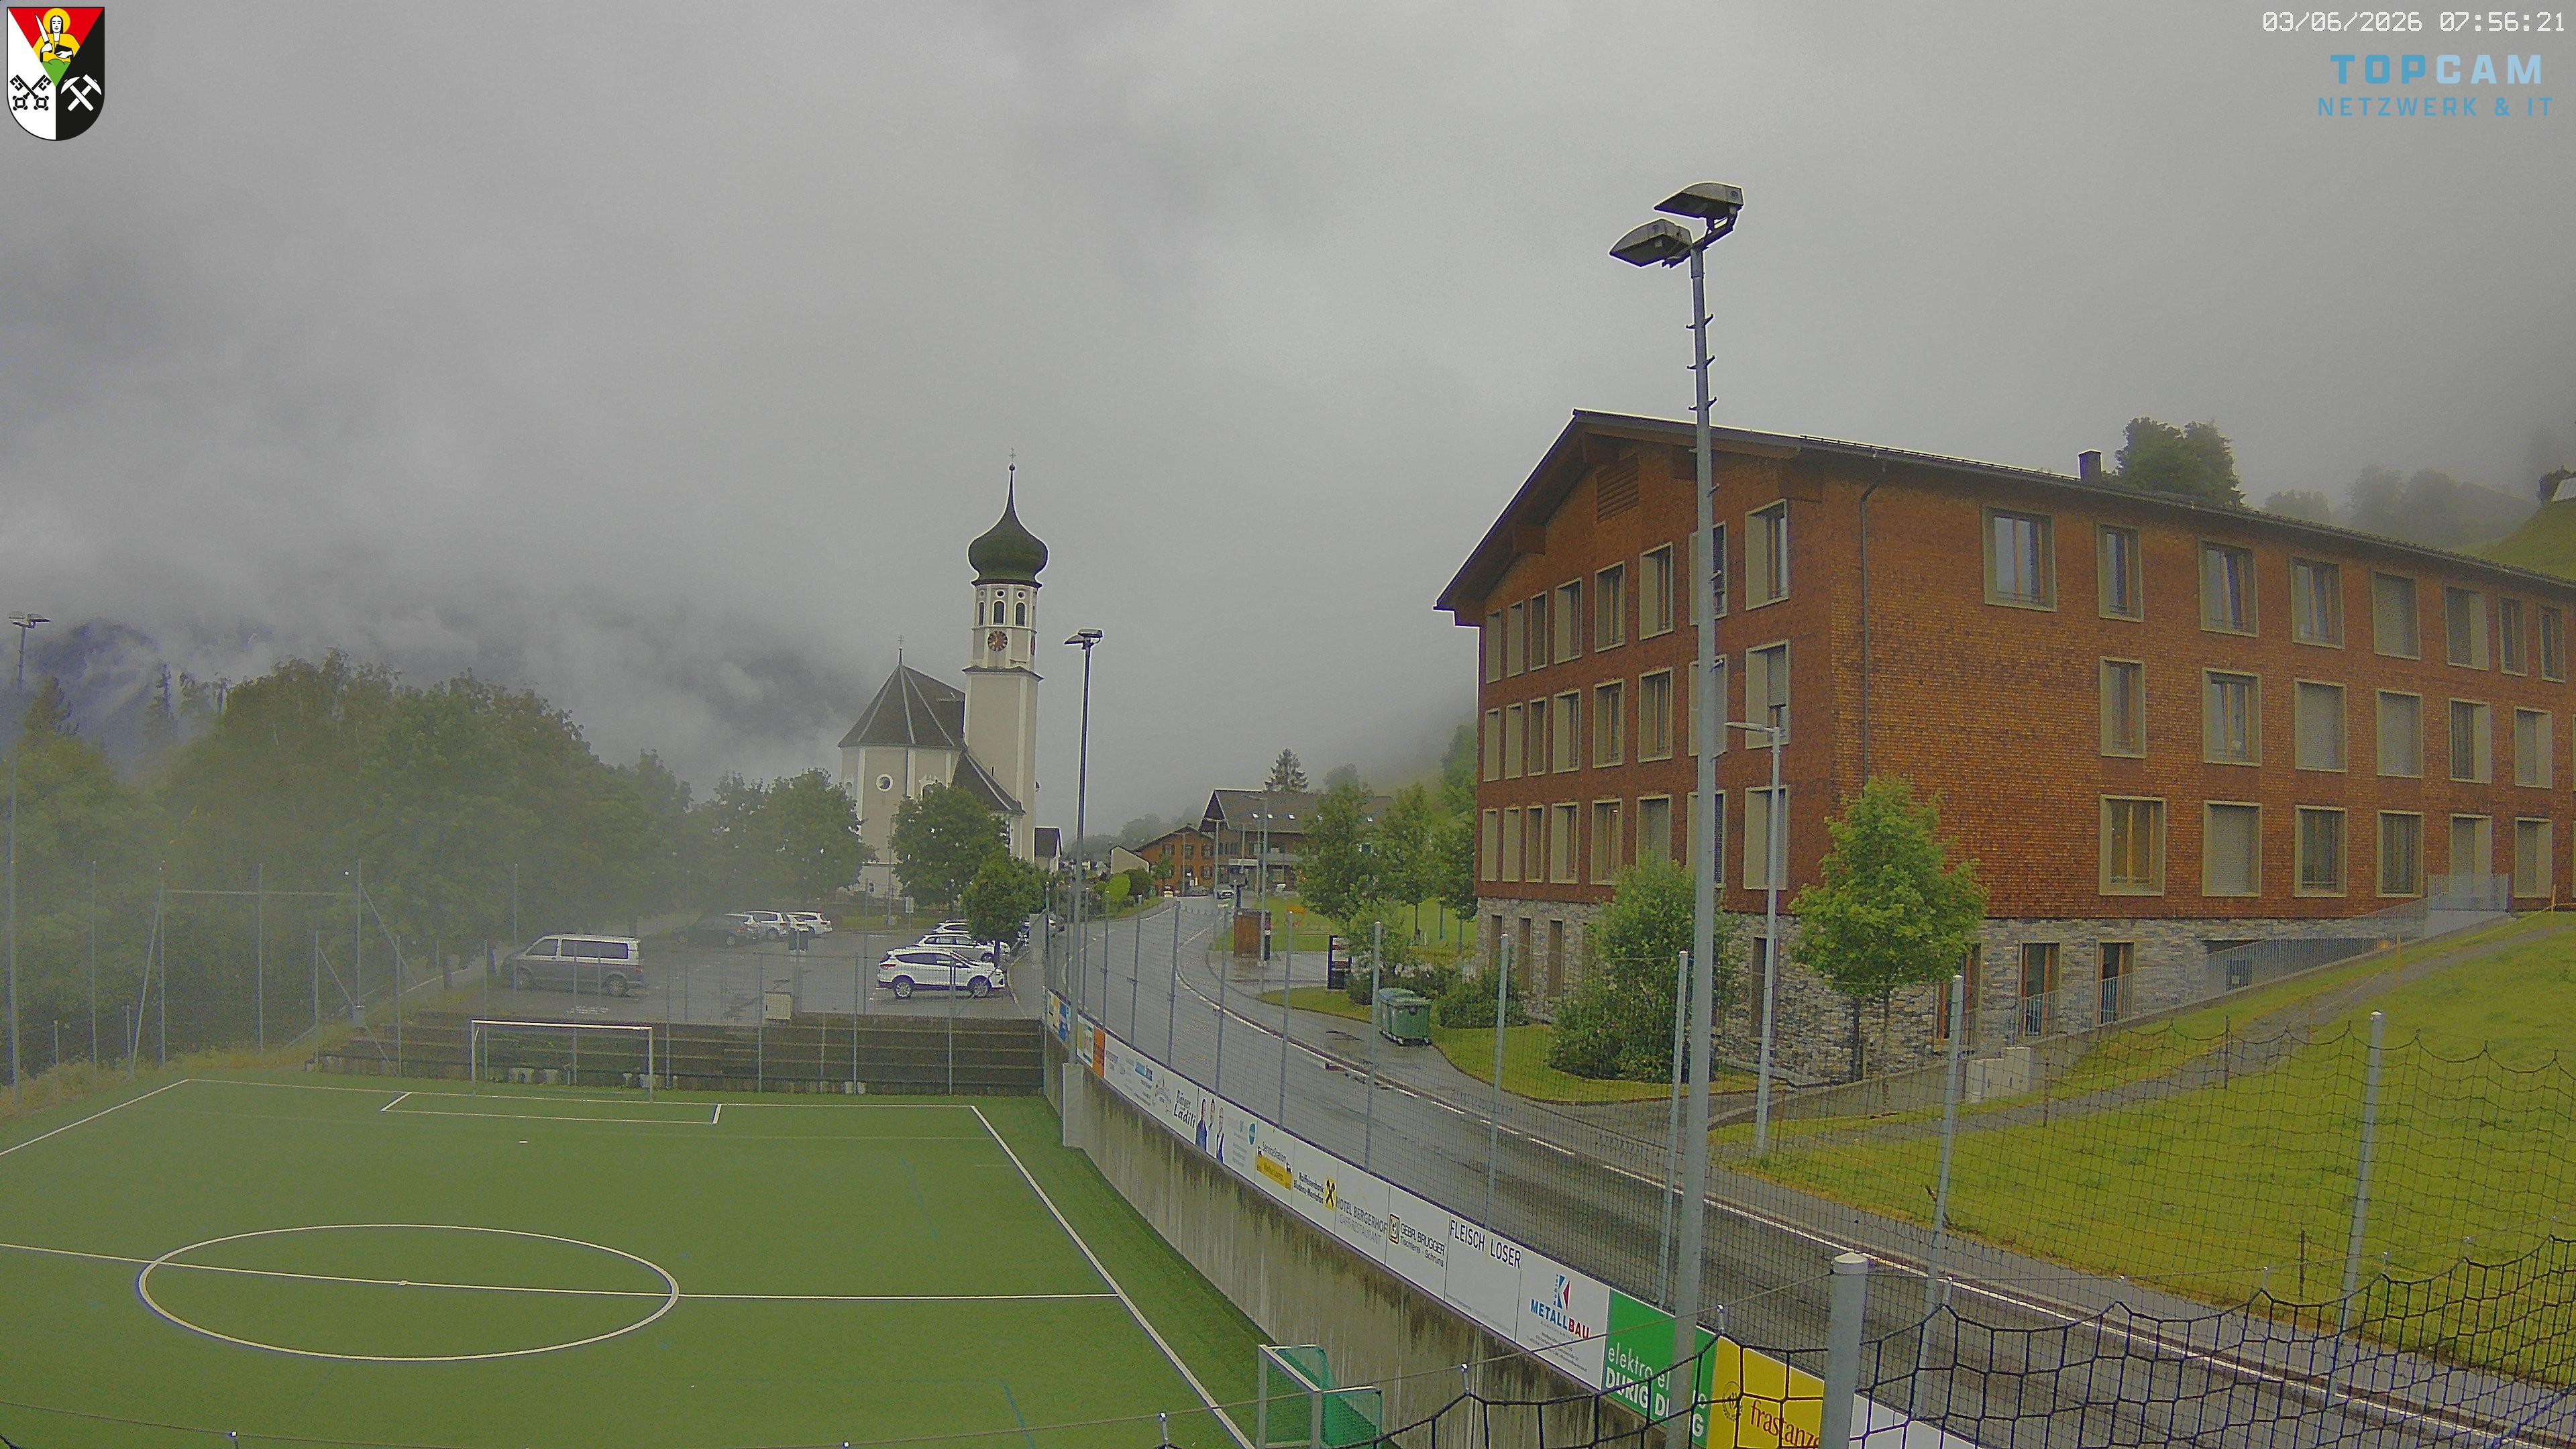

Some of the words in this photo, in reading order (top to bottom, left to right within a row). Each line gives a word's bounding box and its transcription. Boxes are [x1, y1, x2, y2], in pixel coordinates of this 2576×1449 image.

[1336, 1196, 1352, 1216] HOTEL
[1353, 1205, 1388, 1234] BERGERHOF
[1400, 1223, 1417, 1241] GEBR.
[1417, 1232, 1446, 1257] BRUGGER
[1424, 1249, 1444, 1268] Schruns
[1450, 1219, 1485, 1252] FLEISCH
[1490, 1238, 1521, 1270] LOSER
[1530, 1299, 1590, 1339] METALLBAU
[1608, 1342, 1653, 1379] elektro
